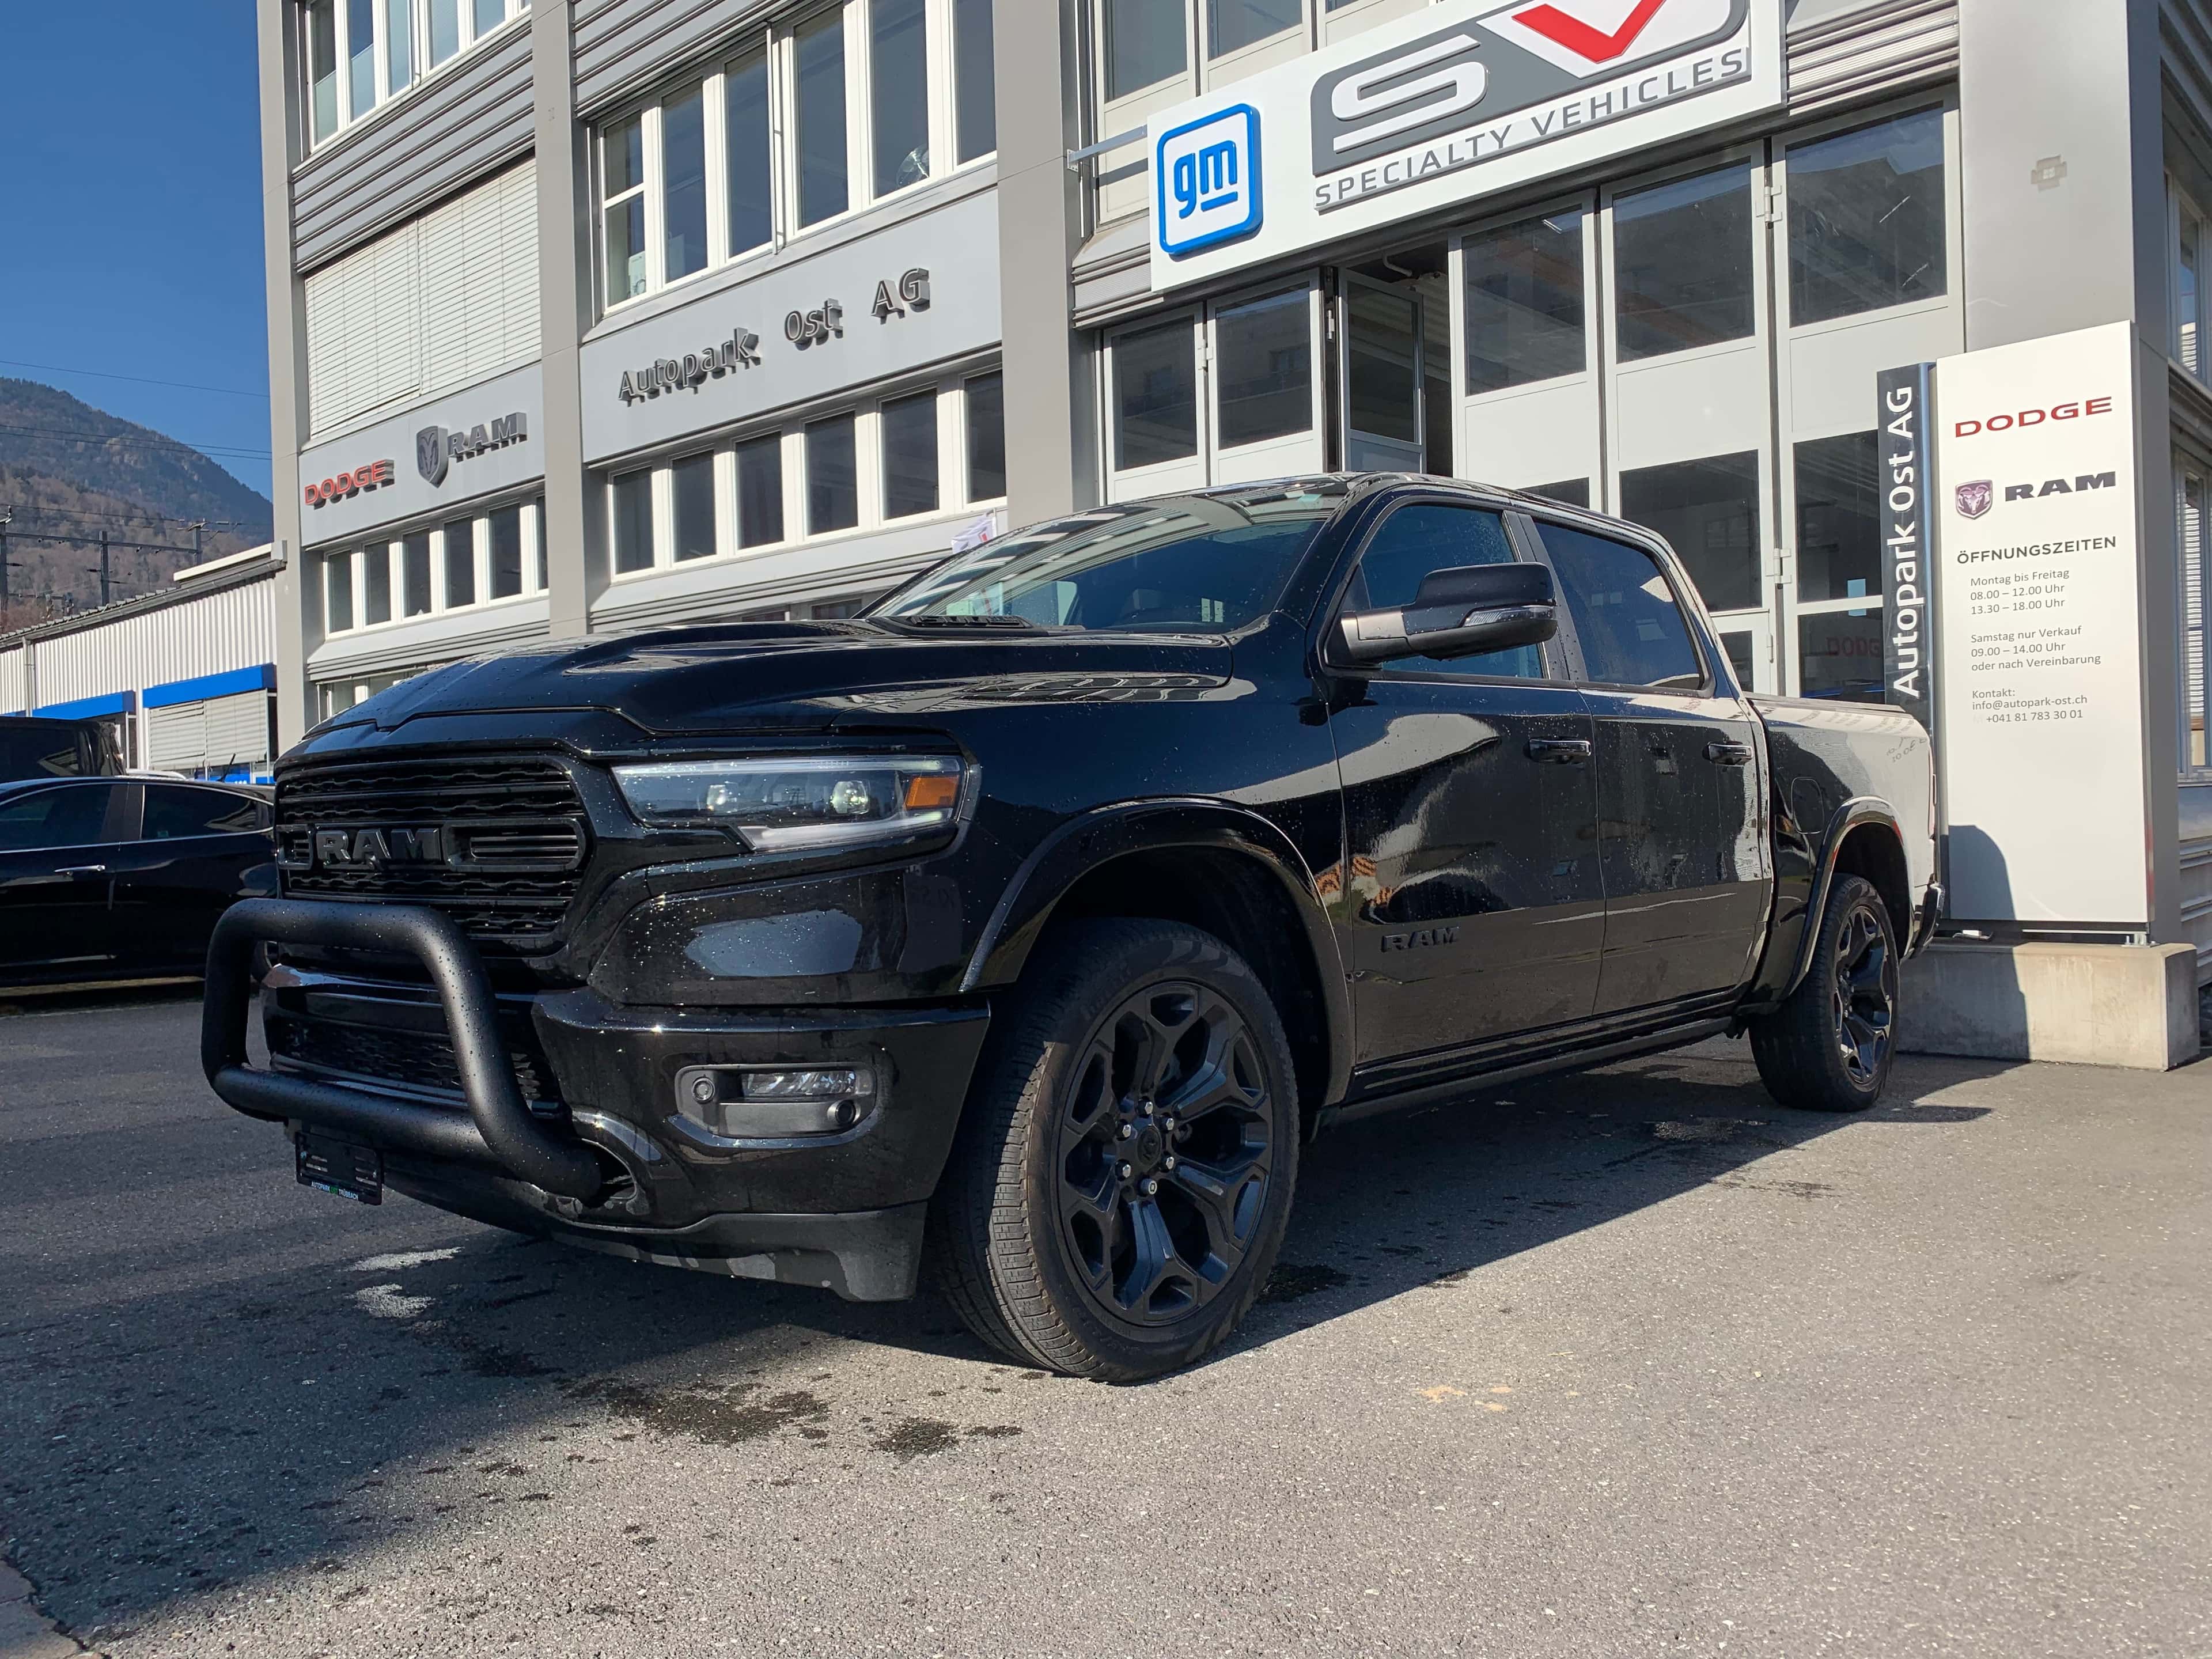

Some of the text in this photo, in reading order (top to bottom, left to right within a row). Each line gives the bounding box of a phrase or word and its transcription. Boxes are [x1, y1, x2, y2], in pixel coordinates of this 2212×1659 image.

[1315, 48, 1743, 207] SPECIALTY VEHICLES
[1173, 140, 1239, 219] gm
[618, 268, 925, 402] Autopark Ost AG
[1955, 396, 2112, 438] DODGE
[448, 412, 523, 456] RAM
[305, 460, 388, 505] DODGE
[2005, 471, 2116, 502] RAM
[1887, 387, 1925, 699] Autopark Ost AG
[1957, 536, 2116, 564] ÖFFNUNGSZEITEN
[1971, 570, 2070, 586] Montag bis Freitag
[1970, 590, 1999, 601] 08.00
[2012, 585, 2041, 597] 12.00
[2045, 584, 2065, 593] Uhr
[1971, 604, 2000, 615] 13.30
[2013, 600, 2042, 611] 18.00
[2045, 599, 2065, 608] Uhr
[1971, 625, 2082, 643] Samstag nur Verkauf
[1971, 647, 2001, 657] 09.00
[2013, 643, 2042, 654] 14.00
[2046, 642, 2066, 652] Uhr
[1971, 656, 2101, 671] oder nach Vereinbarung
[1972, 688, 2016, 699] Kontakt:
[1972, 695, 2088, 710] info@autopark-ost.ch
[1986, 709, 2084, 723] +041 81 783 30 01
[315, 827, 441, 863] RAM
[1382, 926, 1459, 952] RAM
